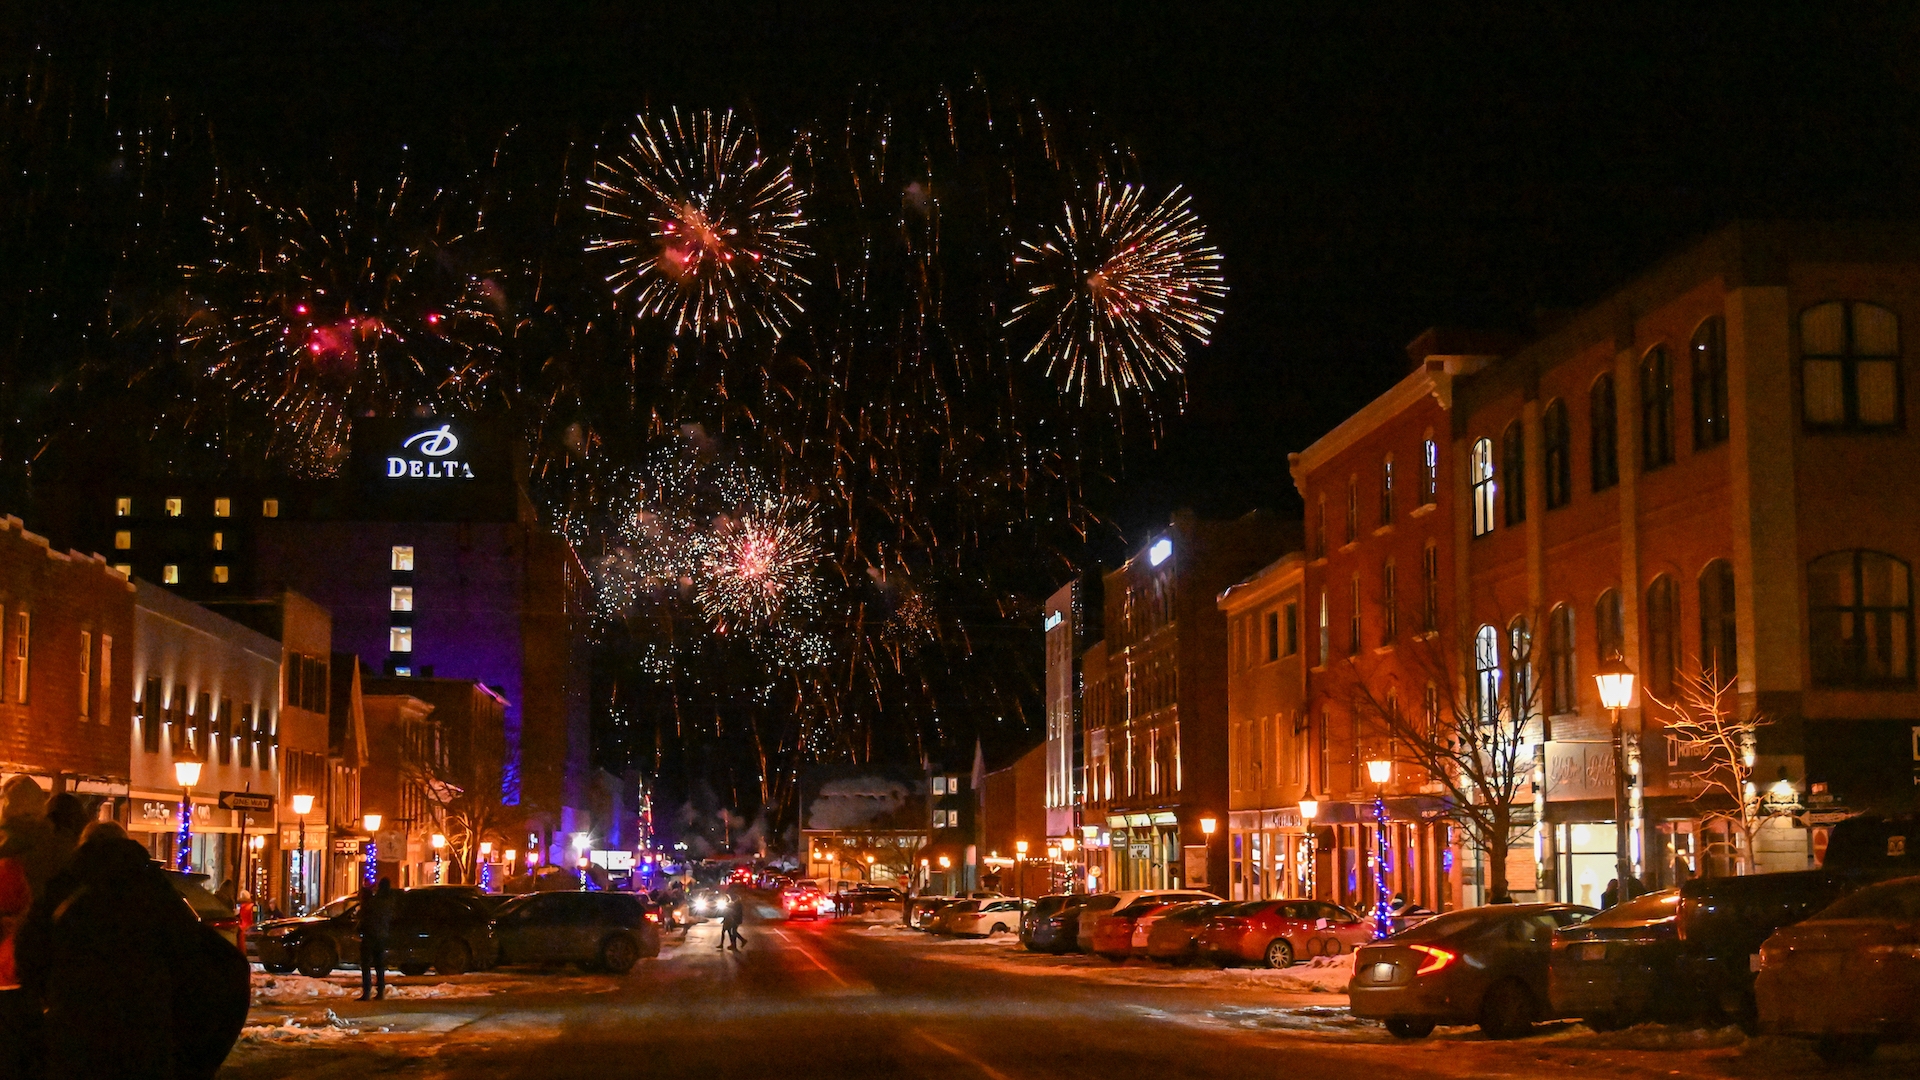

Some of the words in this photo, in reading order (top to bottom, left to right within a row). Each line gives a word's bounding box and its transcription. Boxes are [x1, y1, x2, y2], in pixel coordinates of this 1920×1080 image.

[387, 456, 475, 479] DELTA
[233, 797, 249, 805] ONE
[251, 799, 268, 807] WAY
